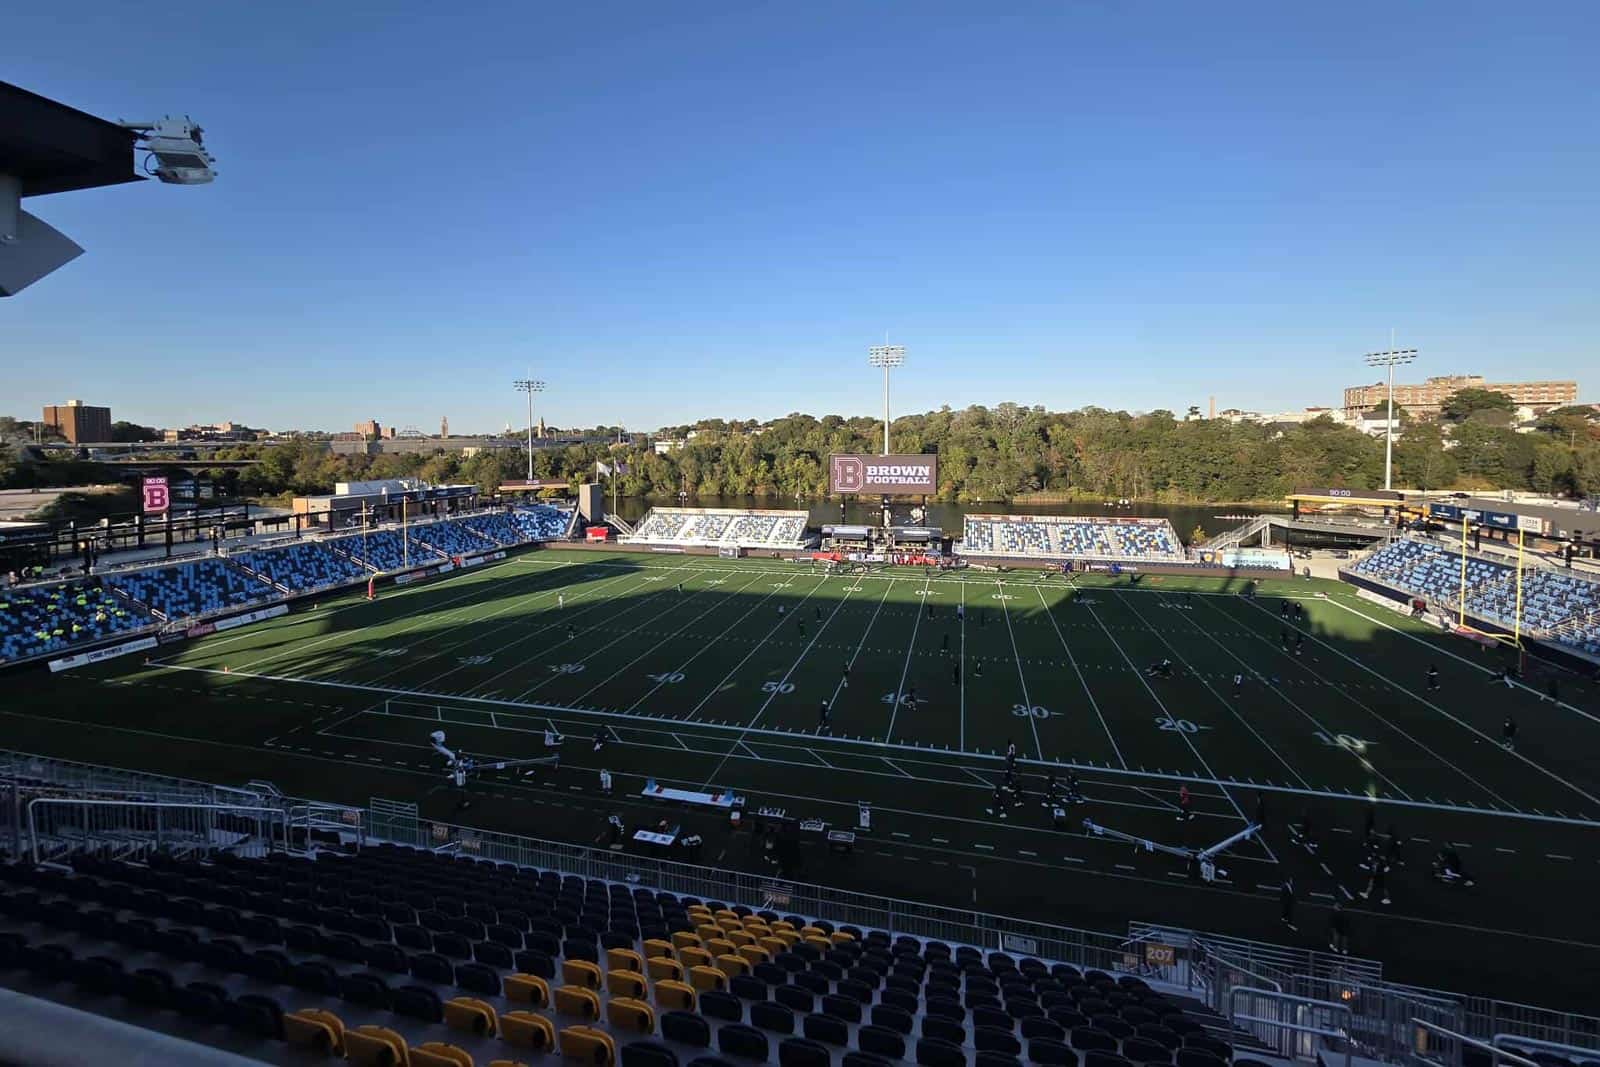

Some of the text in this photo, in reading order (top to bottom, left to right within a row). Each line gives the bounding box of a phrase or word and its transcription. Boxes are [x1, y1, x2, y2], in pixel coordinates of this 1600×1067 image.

[835, 457, 863, 491] B
[866, 465, 930, 476] BROWN
[866, 476, 930, 484] FOOTBALL
[144, 485, 169, 511] B
[761, 681, 795, 694] 50
[1011, 704, 1049, 719] 30
[1154, 717, 1198, 733] 20
[1147, 949, 1174, 961] 207
